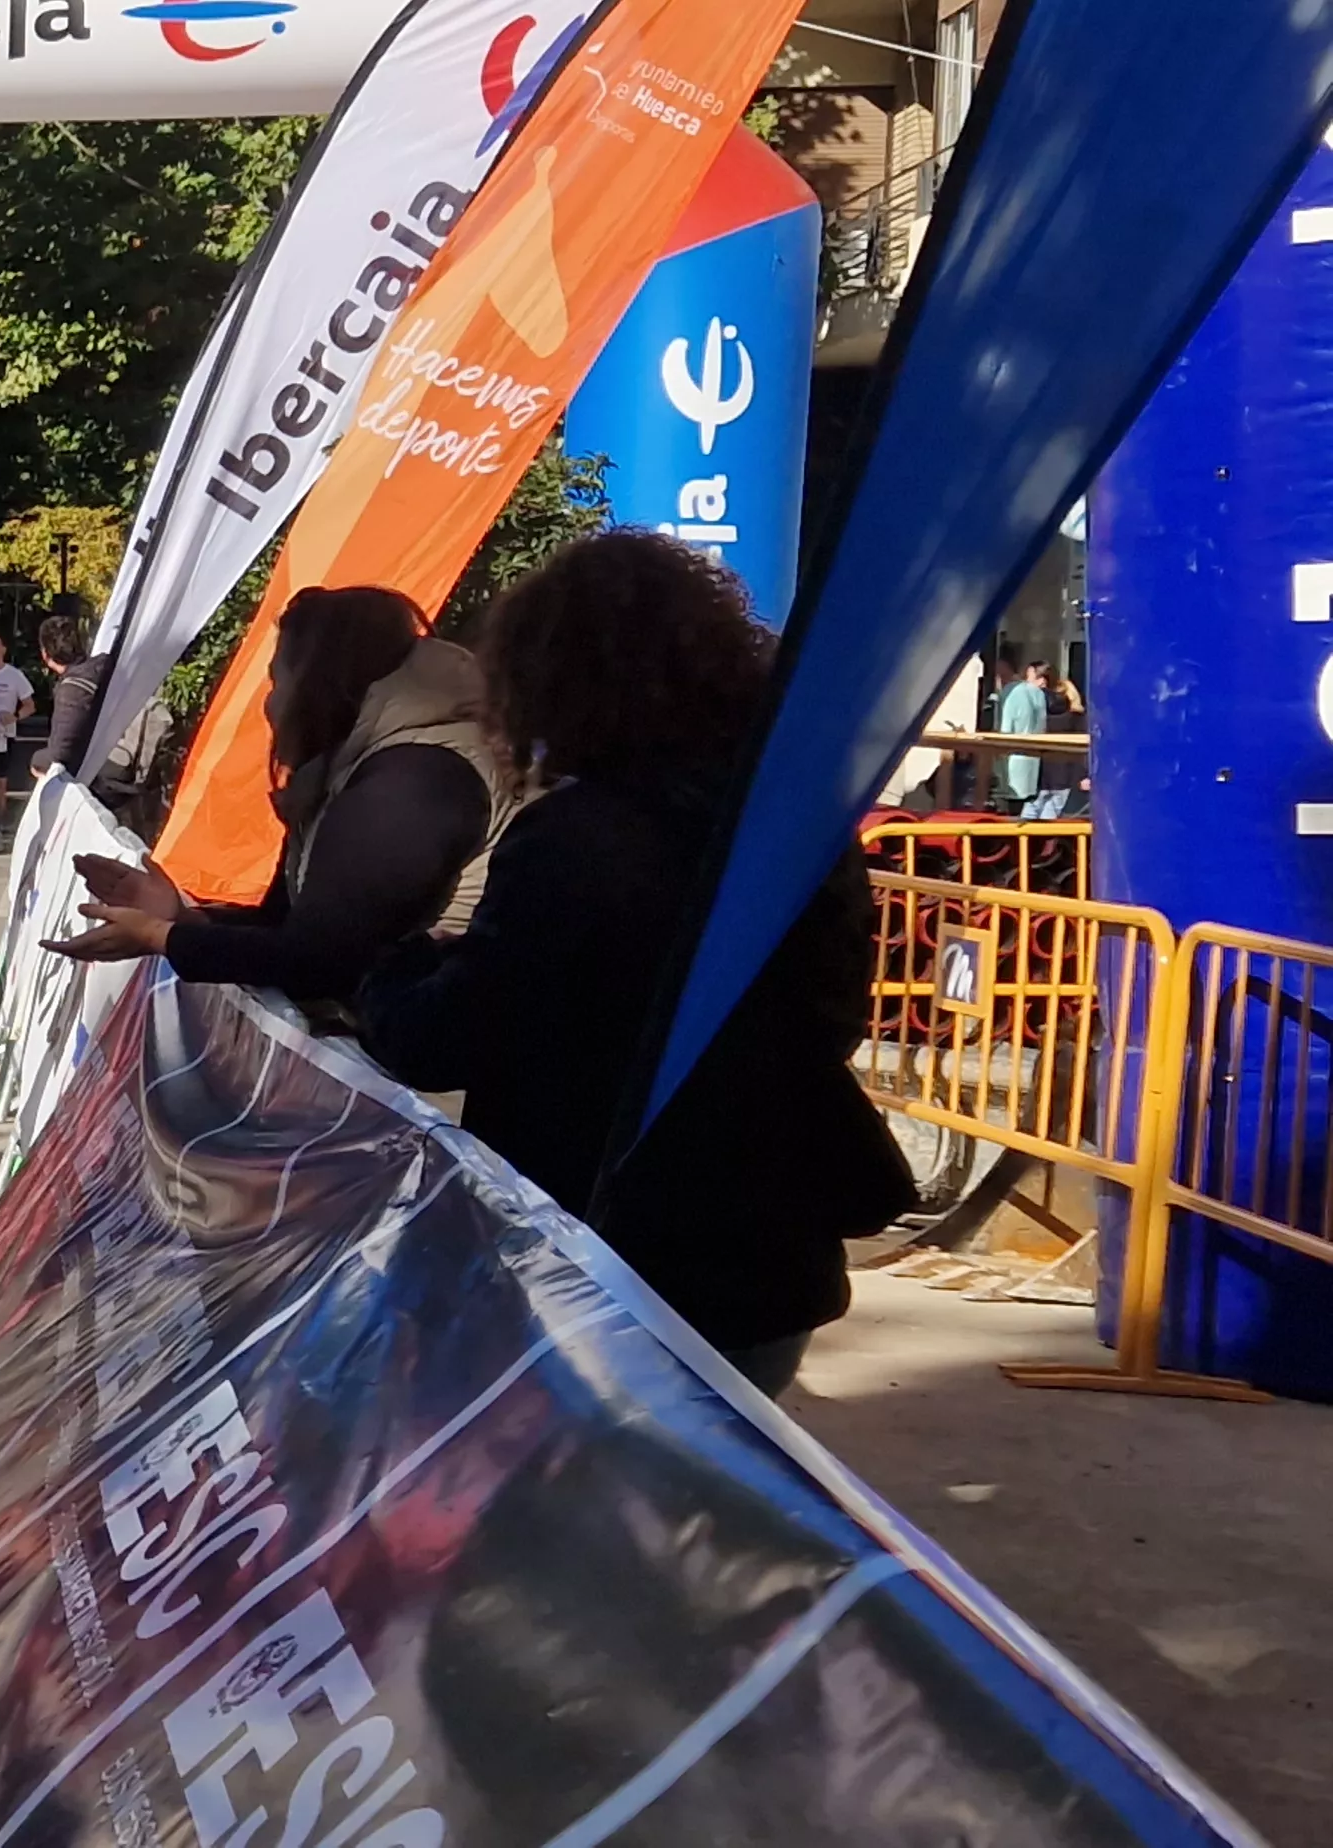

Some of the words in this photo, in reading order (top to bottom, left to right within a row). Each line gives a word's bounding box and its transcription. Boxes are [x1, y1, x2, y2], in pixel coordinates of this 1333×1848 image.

[632, 85, 702, 136] Huesca
[205, 180, 475, 523] Ibercaja
[357, 377, 506, 480] deporte
